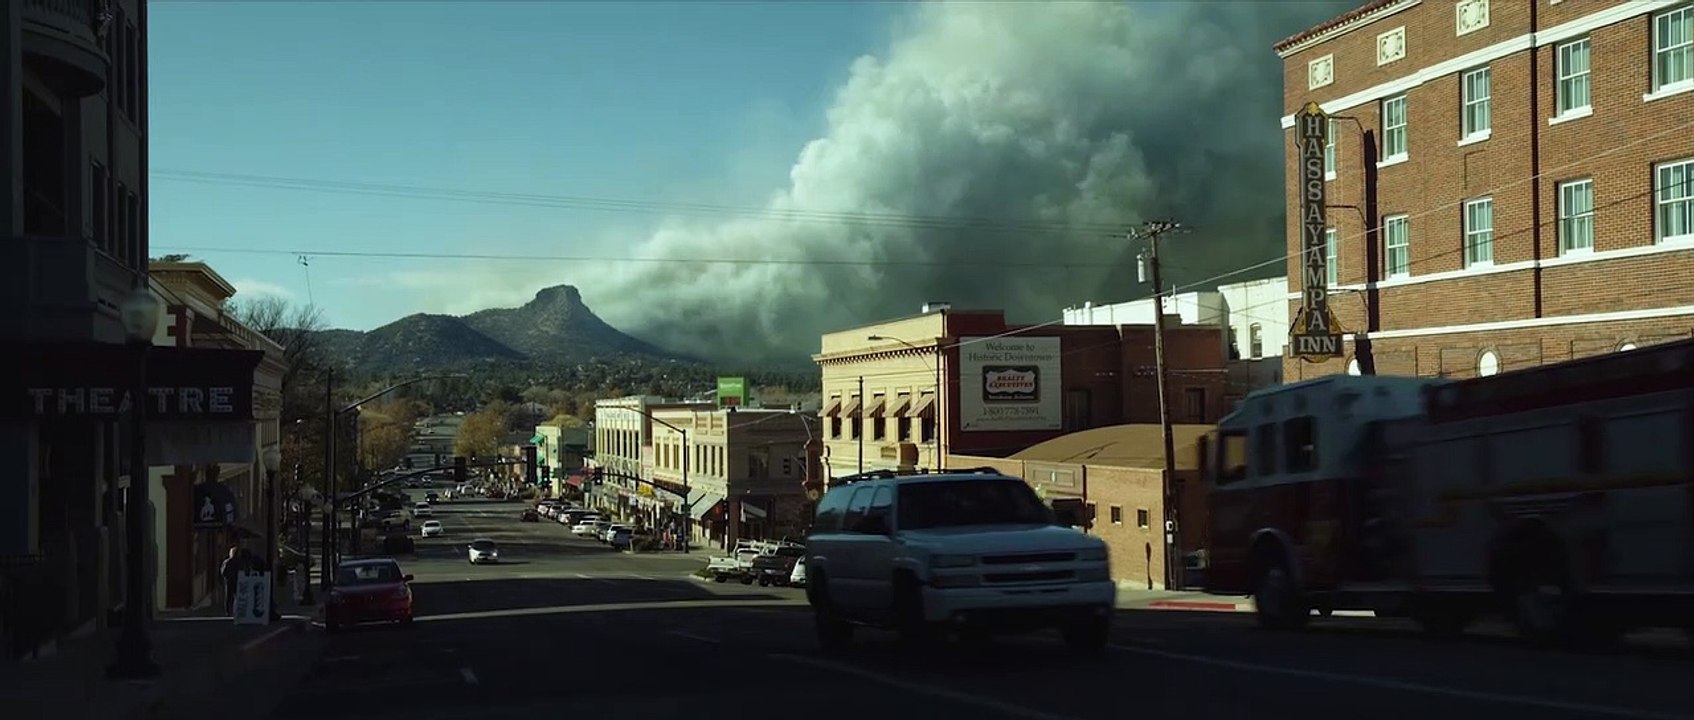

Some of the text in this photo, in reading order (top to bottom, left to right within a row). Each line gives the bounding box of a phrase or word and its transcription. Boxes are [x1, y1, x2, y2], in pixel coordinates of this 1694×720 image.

[1305, 117, 1326, 331] HASSAYAMPA
[986, 343, 1035, 351] Welcome to
[1299, 335, 1337, 354] INN
[968, 352, 1052, 361] Historic Downtown
